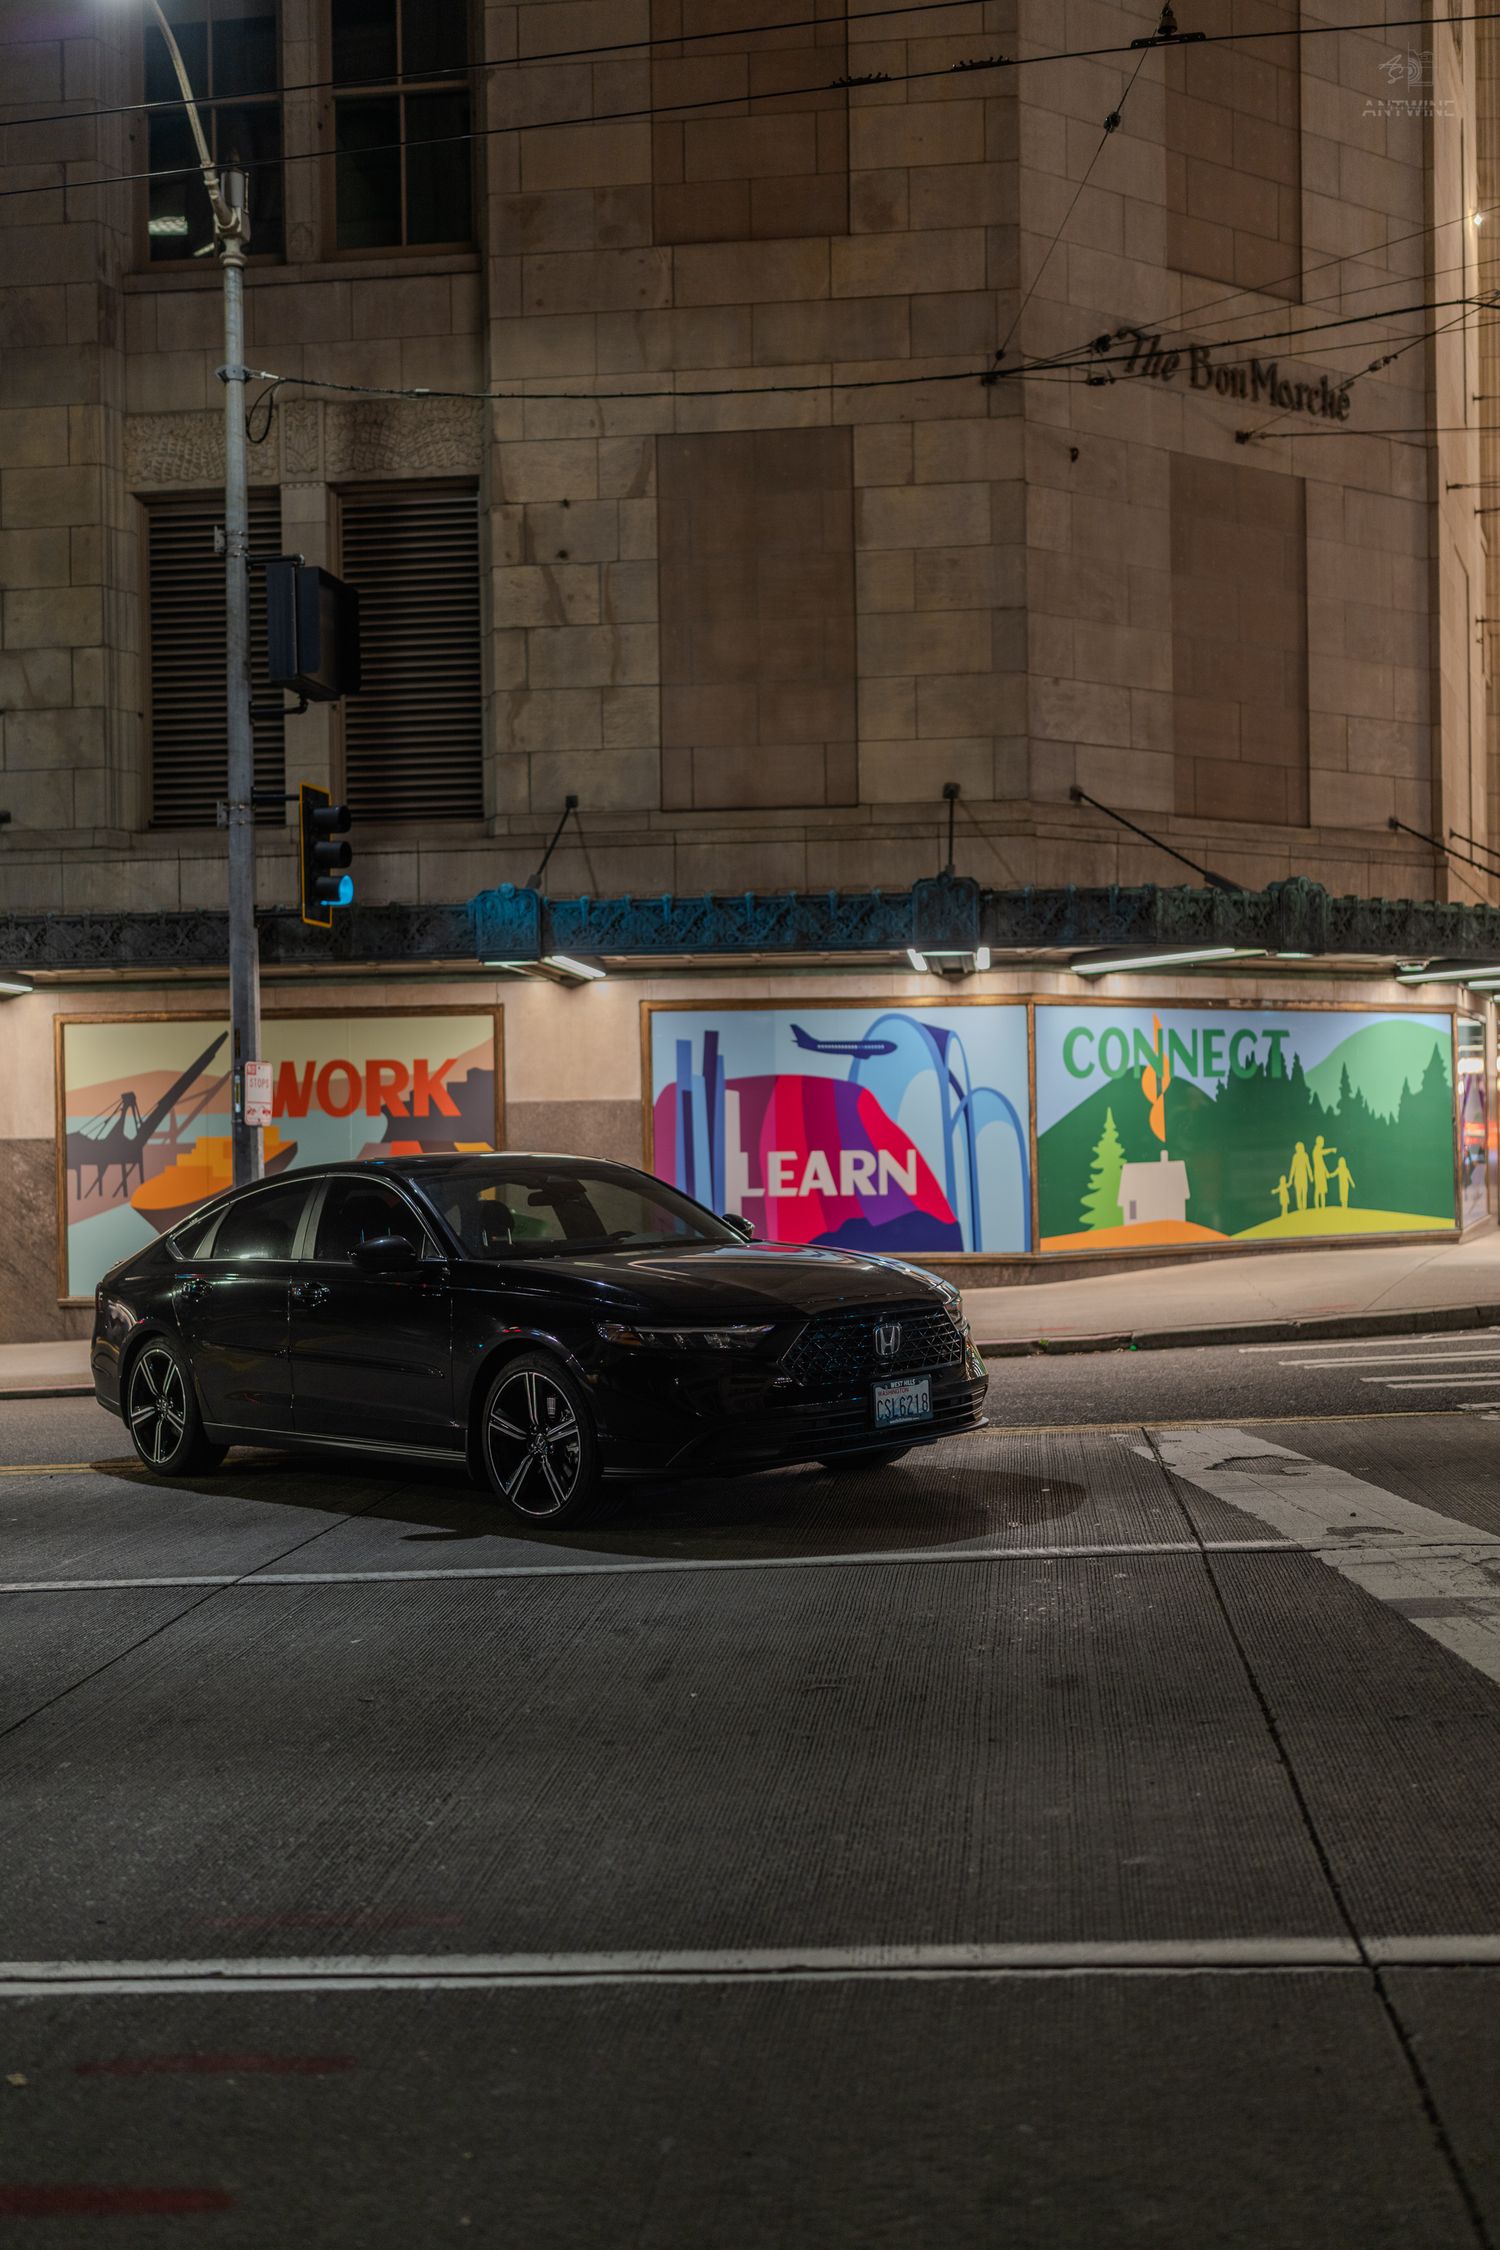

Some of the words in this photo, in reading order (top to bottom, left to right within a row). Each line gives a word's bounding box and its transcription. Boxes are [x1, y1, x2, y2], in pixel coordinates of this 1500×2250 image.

[1117, 327, 1181, 382] The
[1189, 344, 1249, 400] Bon
[1063, 1026, 1290, 1079] CONNECT
[272, 1058, 462, 1118] WORK
[733, 1149, 918, 1197] LEARN
[877, 1392, 929, 1420] CSL6218
[878, 1387, 909, 1396] WASHINGTON
